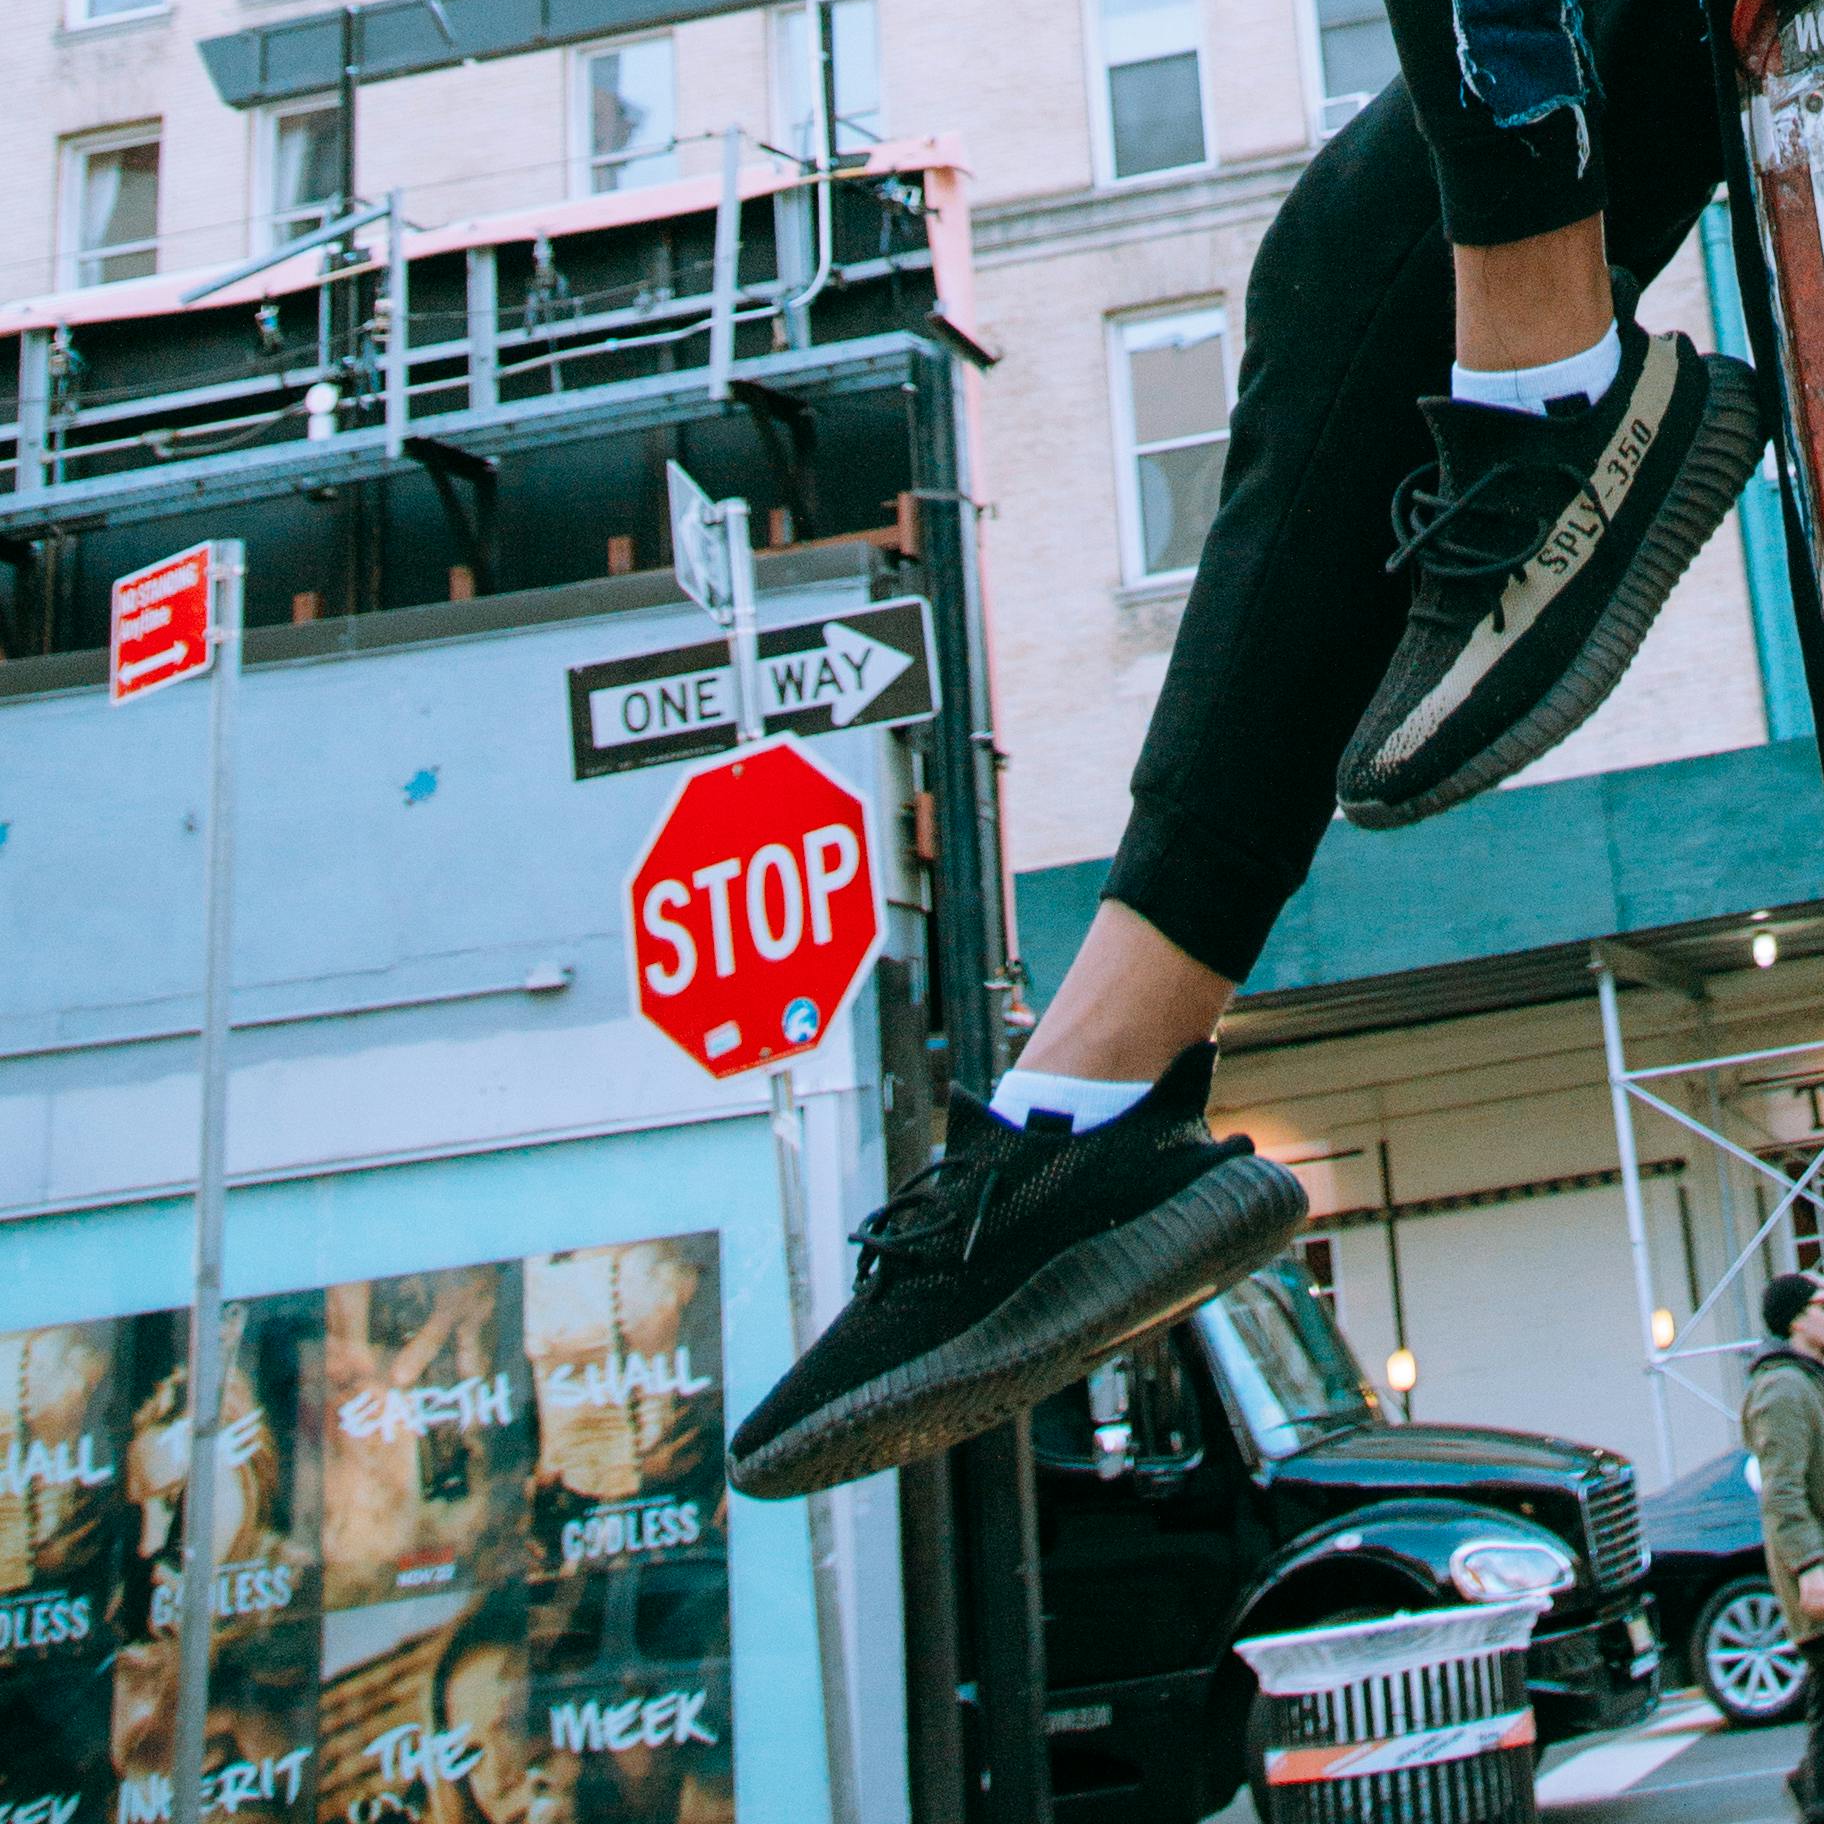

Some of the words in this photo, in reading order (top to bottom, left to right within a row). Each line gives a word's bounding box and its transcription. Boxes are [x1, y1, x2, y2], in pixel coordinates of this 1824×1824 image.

[622, 677, 721, 734] ONE
[771, 649, 874, 706] WAY
[643, 823, 860, 998] STOP
[336, 1372, 513, 1443] EARTH
[547, 1345, 712, 1409] SHALL
[561, 1501, 701, 1562] GODLESS
[150, 1562, 294, 1630] GLESS
[362, 1721, 487, 1788] THE
[547, 1689, 719, 1755] MEEK
